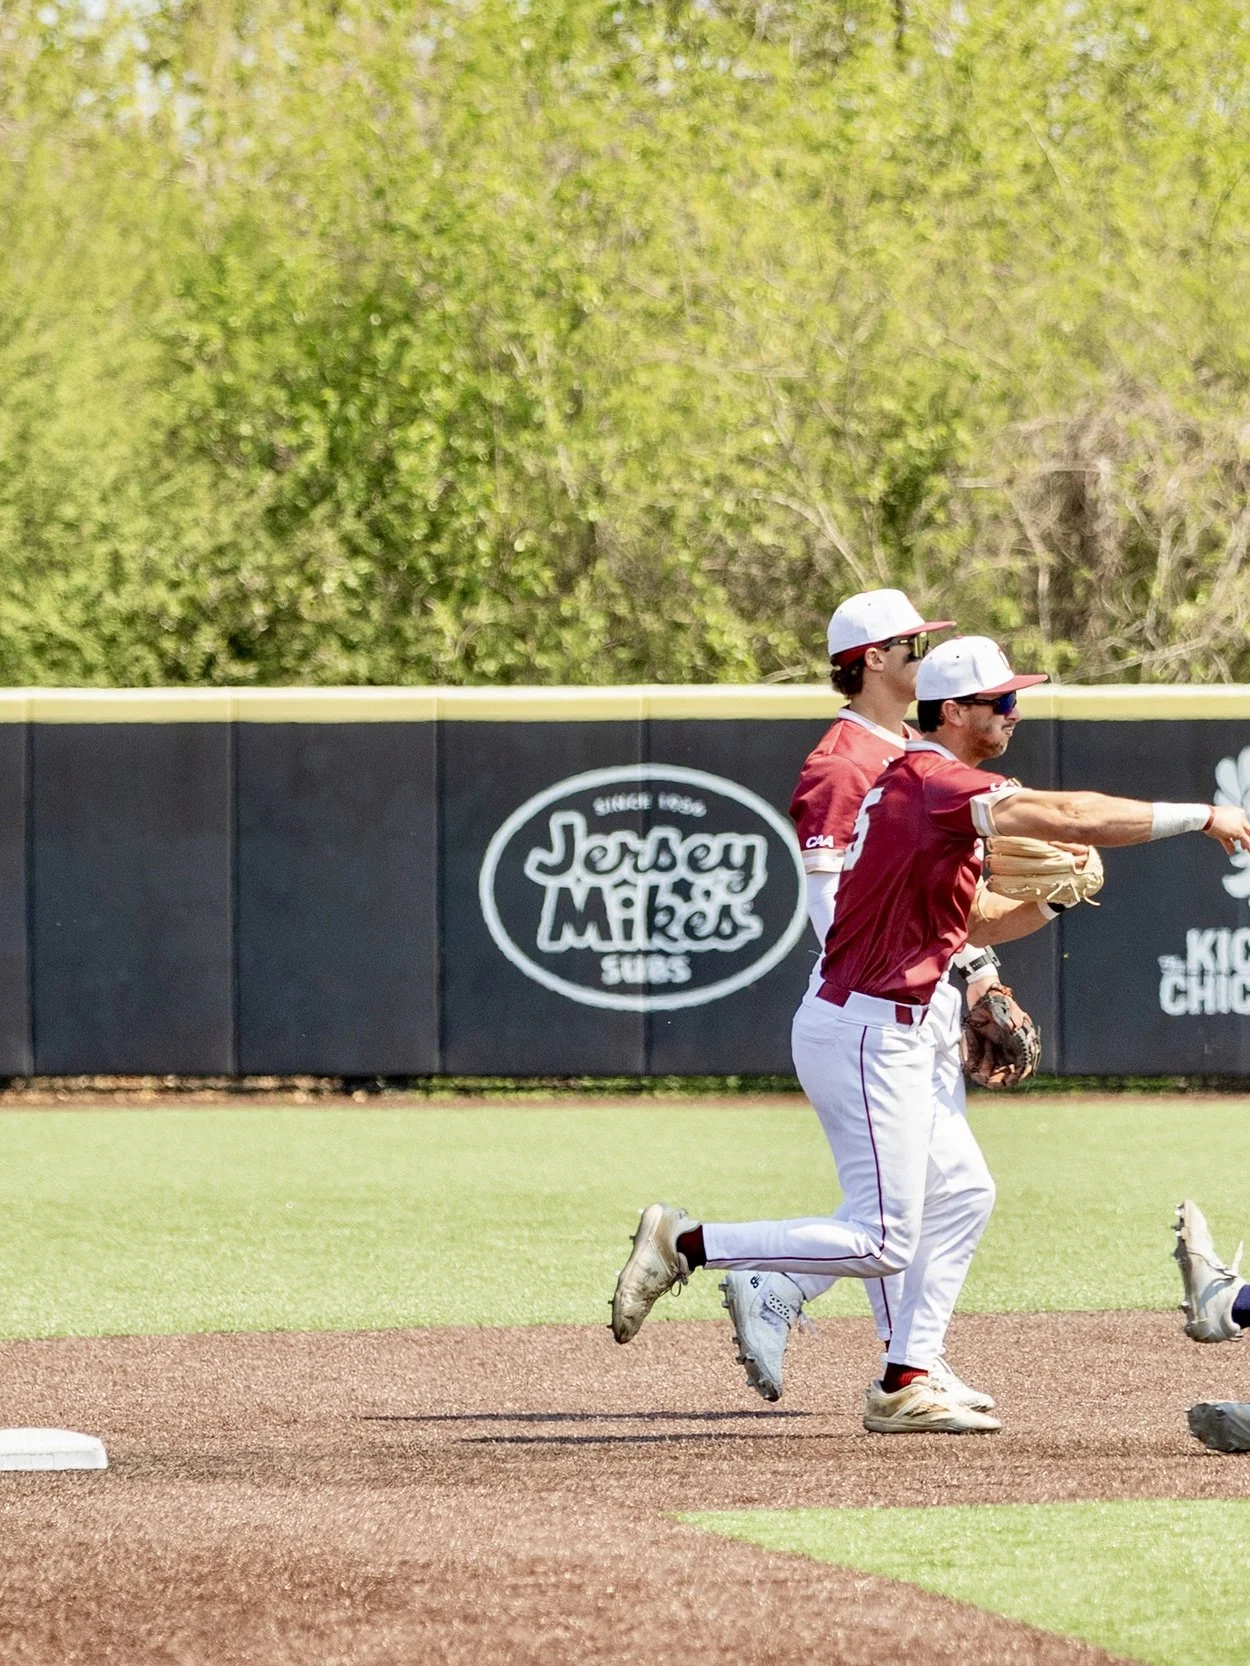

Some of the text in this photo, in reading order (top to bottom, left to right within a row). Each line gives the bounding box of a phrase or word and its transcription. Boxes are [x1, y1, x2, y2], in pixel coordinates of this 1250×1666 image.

[593, 791, 653, 816] SINCE
[524, 811, 767, 896] Jersey
[806, 835, 834, 848] CAA
[601, 954, 692, 985] SUBS
